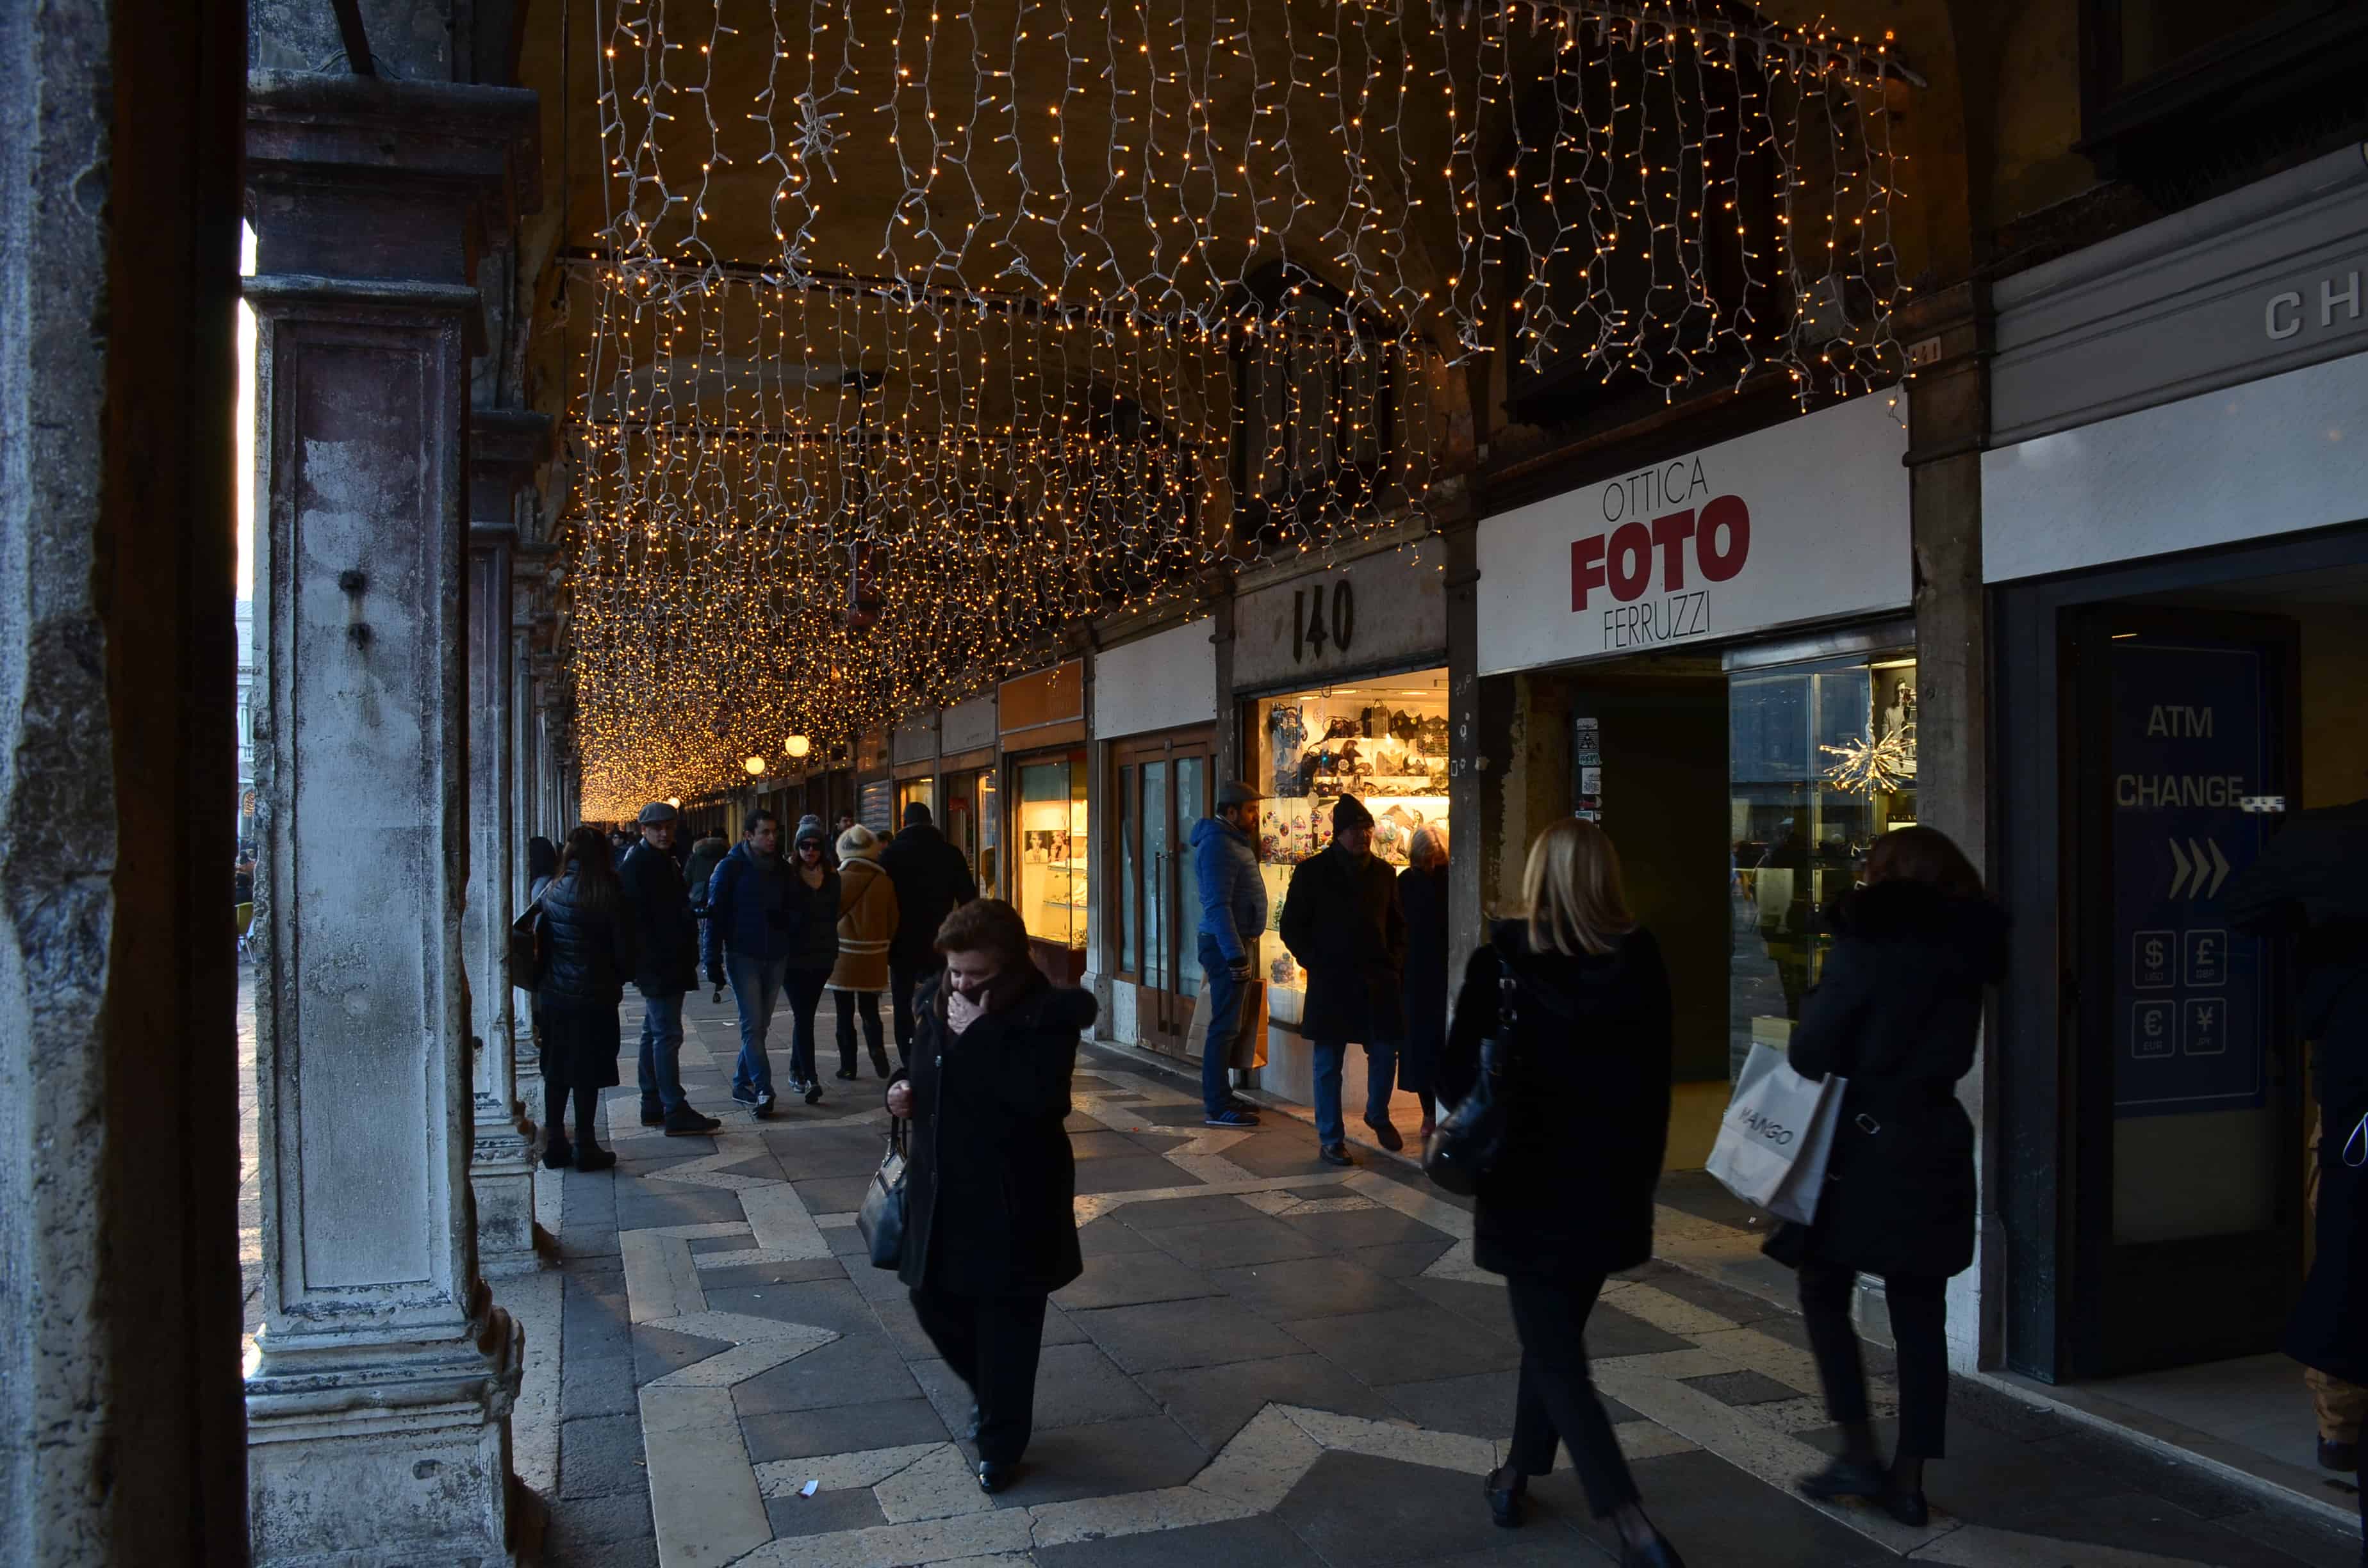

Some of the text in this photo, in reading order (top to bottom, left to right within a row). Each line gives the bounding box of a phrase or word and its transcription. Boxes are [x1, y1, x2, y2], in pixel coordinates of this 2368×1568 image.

[2265, 271, 2360, 341] CH
[1602, 455, 1709, 522] OTTICA
[1571, 494, 1750, 612] FOTO
[1293, 579, 1353, 664] 140
[1604, 590, 1710, 649] FERRUZZI
[2147, 705, 2214, 738] ATM
[2116, 773, 2243, 808] CHANGE
